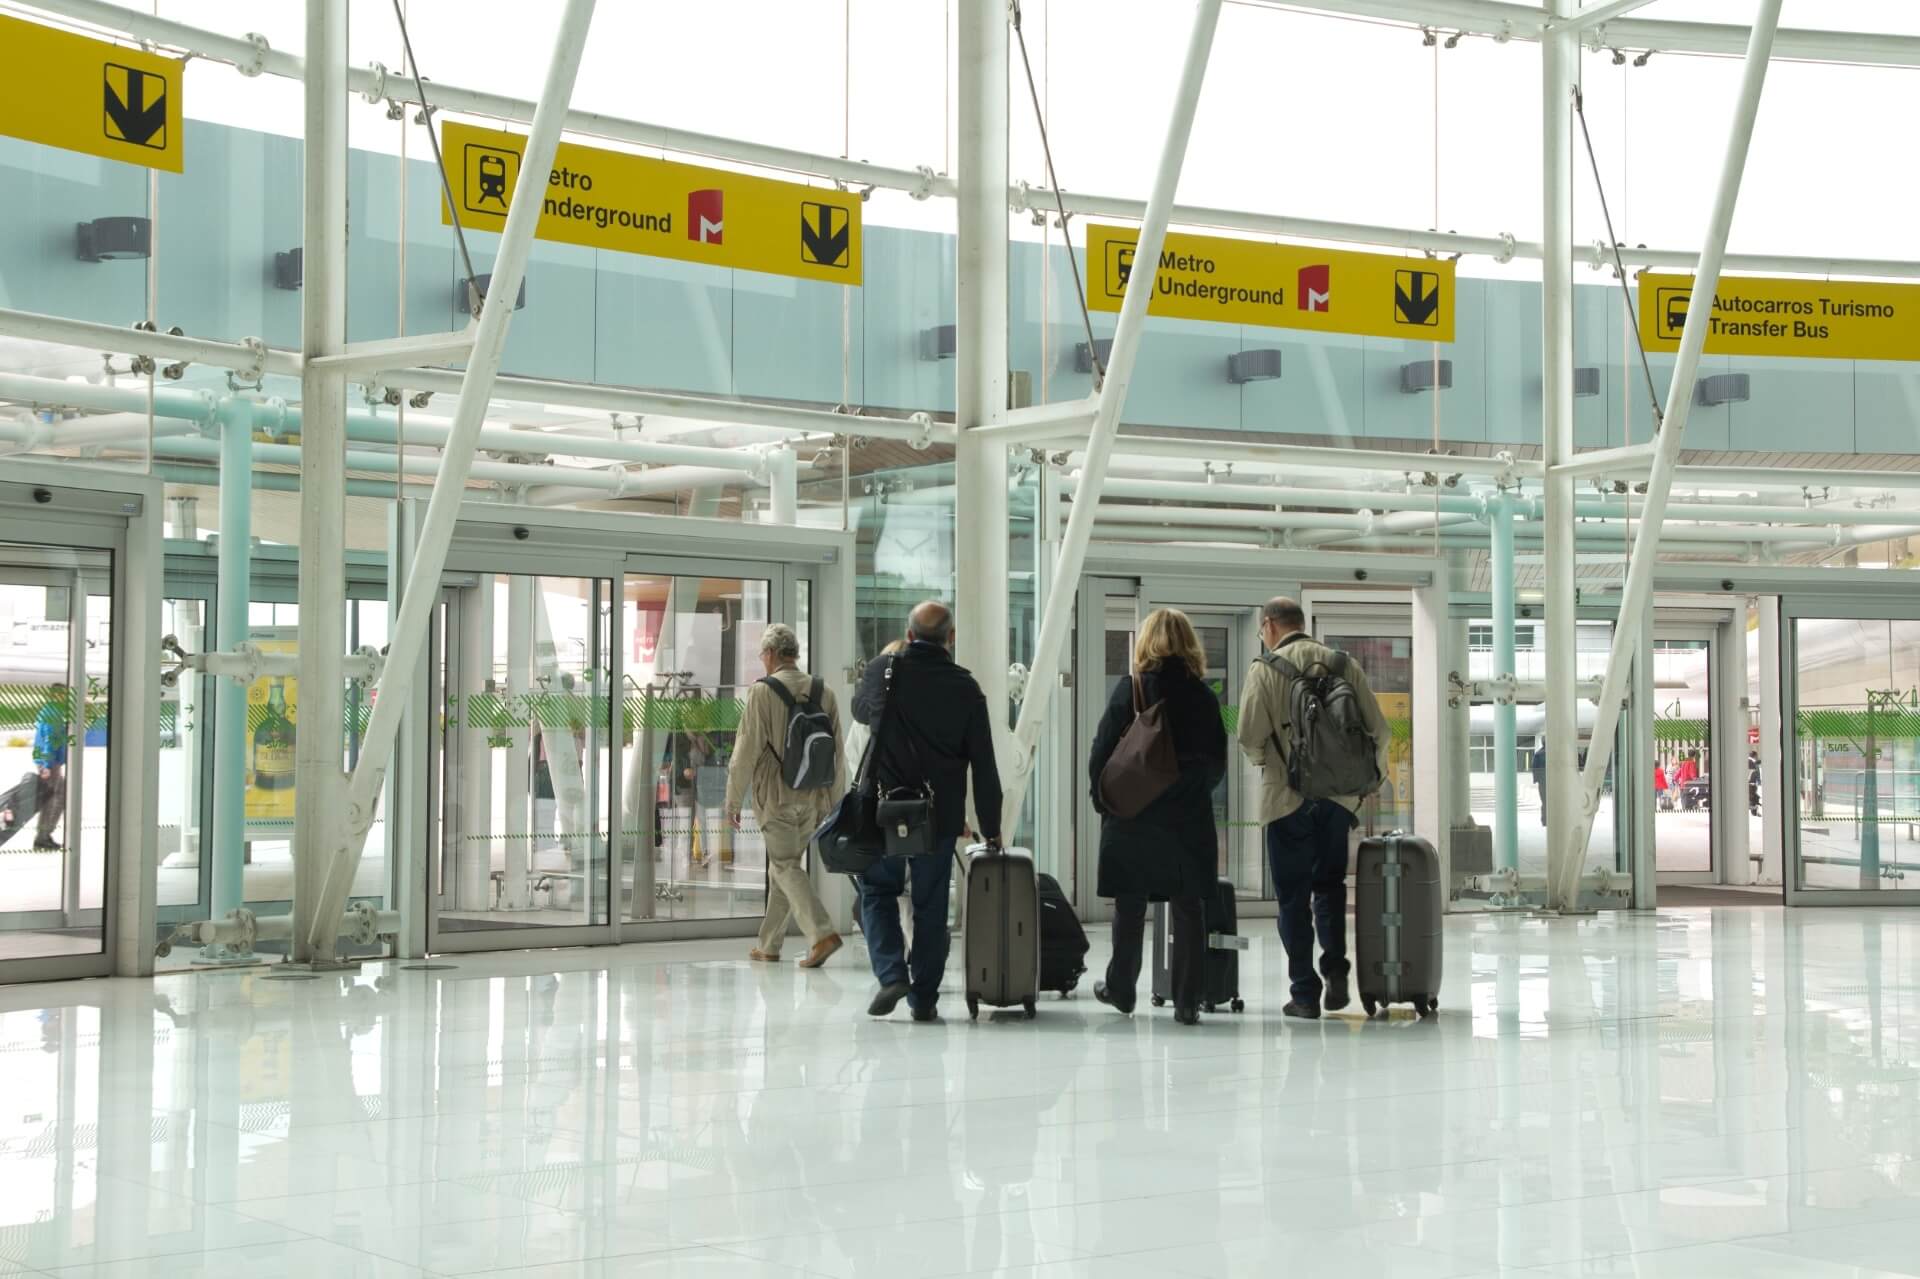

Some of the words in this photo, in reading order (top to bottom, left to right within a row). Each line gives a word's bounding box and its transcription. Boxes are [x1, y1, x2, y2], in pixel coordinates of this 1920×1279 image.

[548, 167, 593, 191] etro
[544, 196, 672, 233] nderground
[1158, 250, 1216, 274] Metro
[1158, 275, 1284, 305] Underground
[1711, 294, 1814, 315] Autocarros
[1819, 298, 1895, 318] Turismo
[1709, 317, 1788, 337] Transfer
[1793, 320, 1829, 339] Bus
